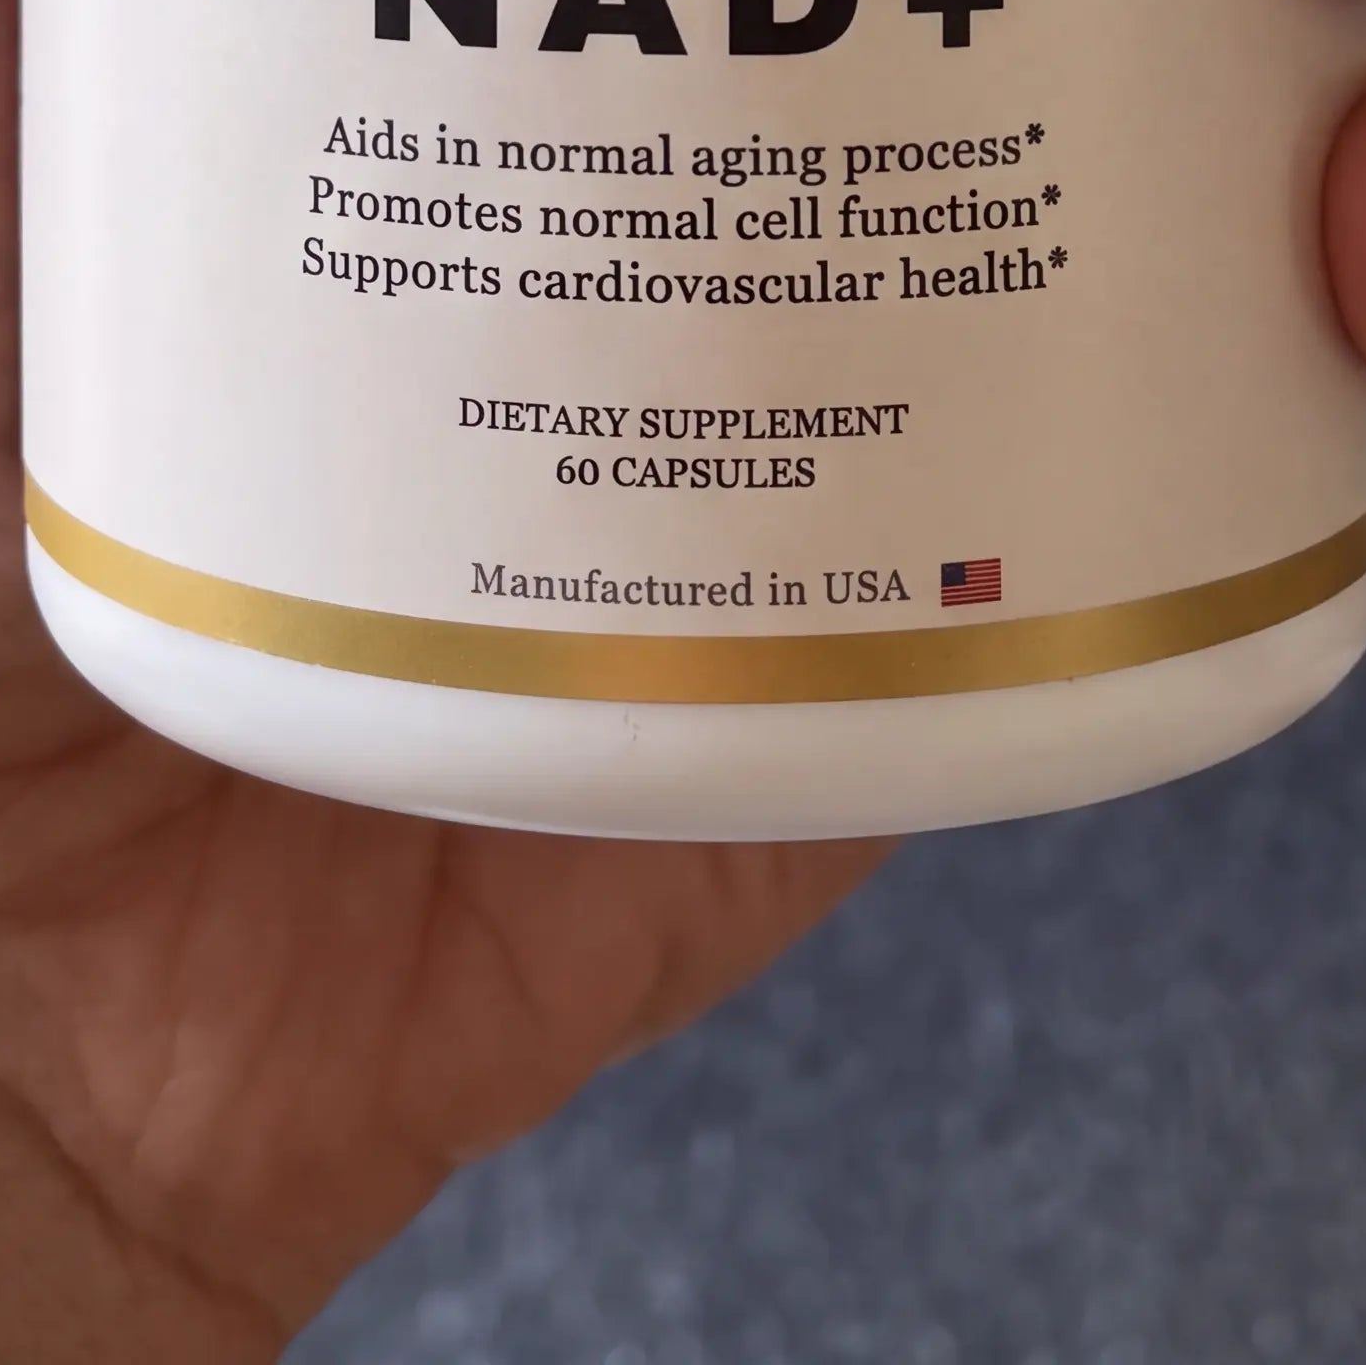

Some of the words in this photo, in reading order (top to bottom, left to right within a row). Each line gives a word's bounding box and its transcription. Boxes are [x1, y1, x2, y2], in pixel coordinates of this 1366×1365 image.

[322, 115, 420, 163] Aids
[435, 122, 482, 168] in
[497, 133, 675, 176] normal
[691, 133, 827, 188] aging
[308, 174, 523, 234] Promotes
[539, 196, 719, 241] normal
[735, 195, 823, 241] cell
[302, 236, 502, 298] Supports
[518, 259, 885, 305] cardiovascular
[458, 396, 631, 438] DIETARY
[639, 403, 910, 440] SUPPLEMENT
[556, 455, 600, 486] 60
[611, 456, 816, 489] CAPSULES
[470, 562, 755, 607] Manufactured
[768, 571, 808, 606] in
[822, 568, 912, 605] USA
